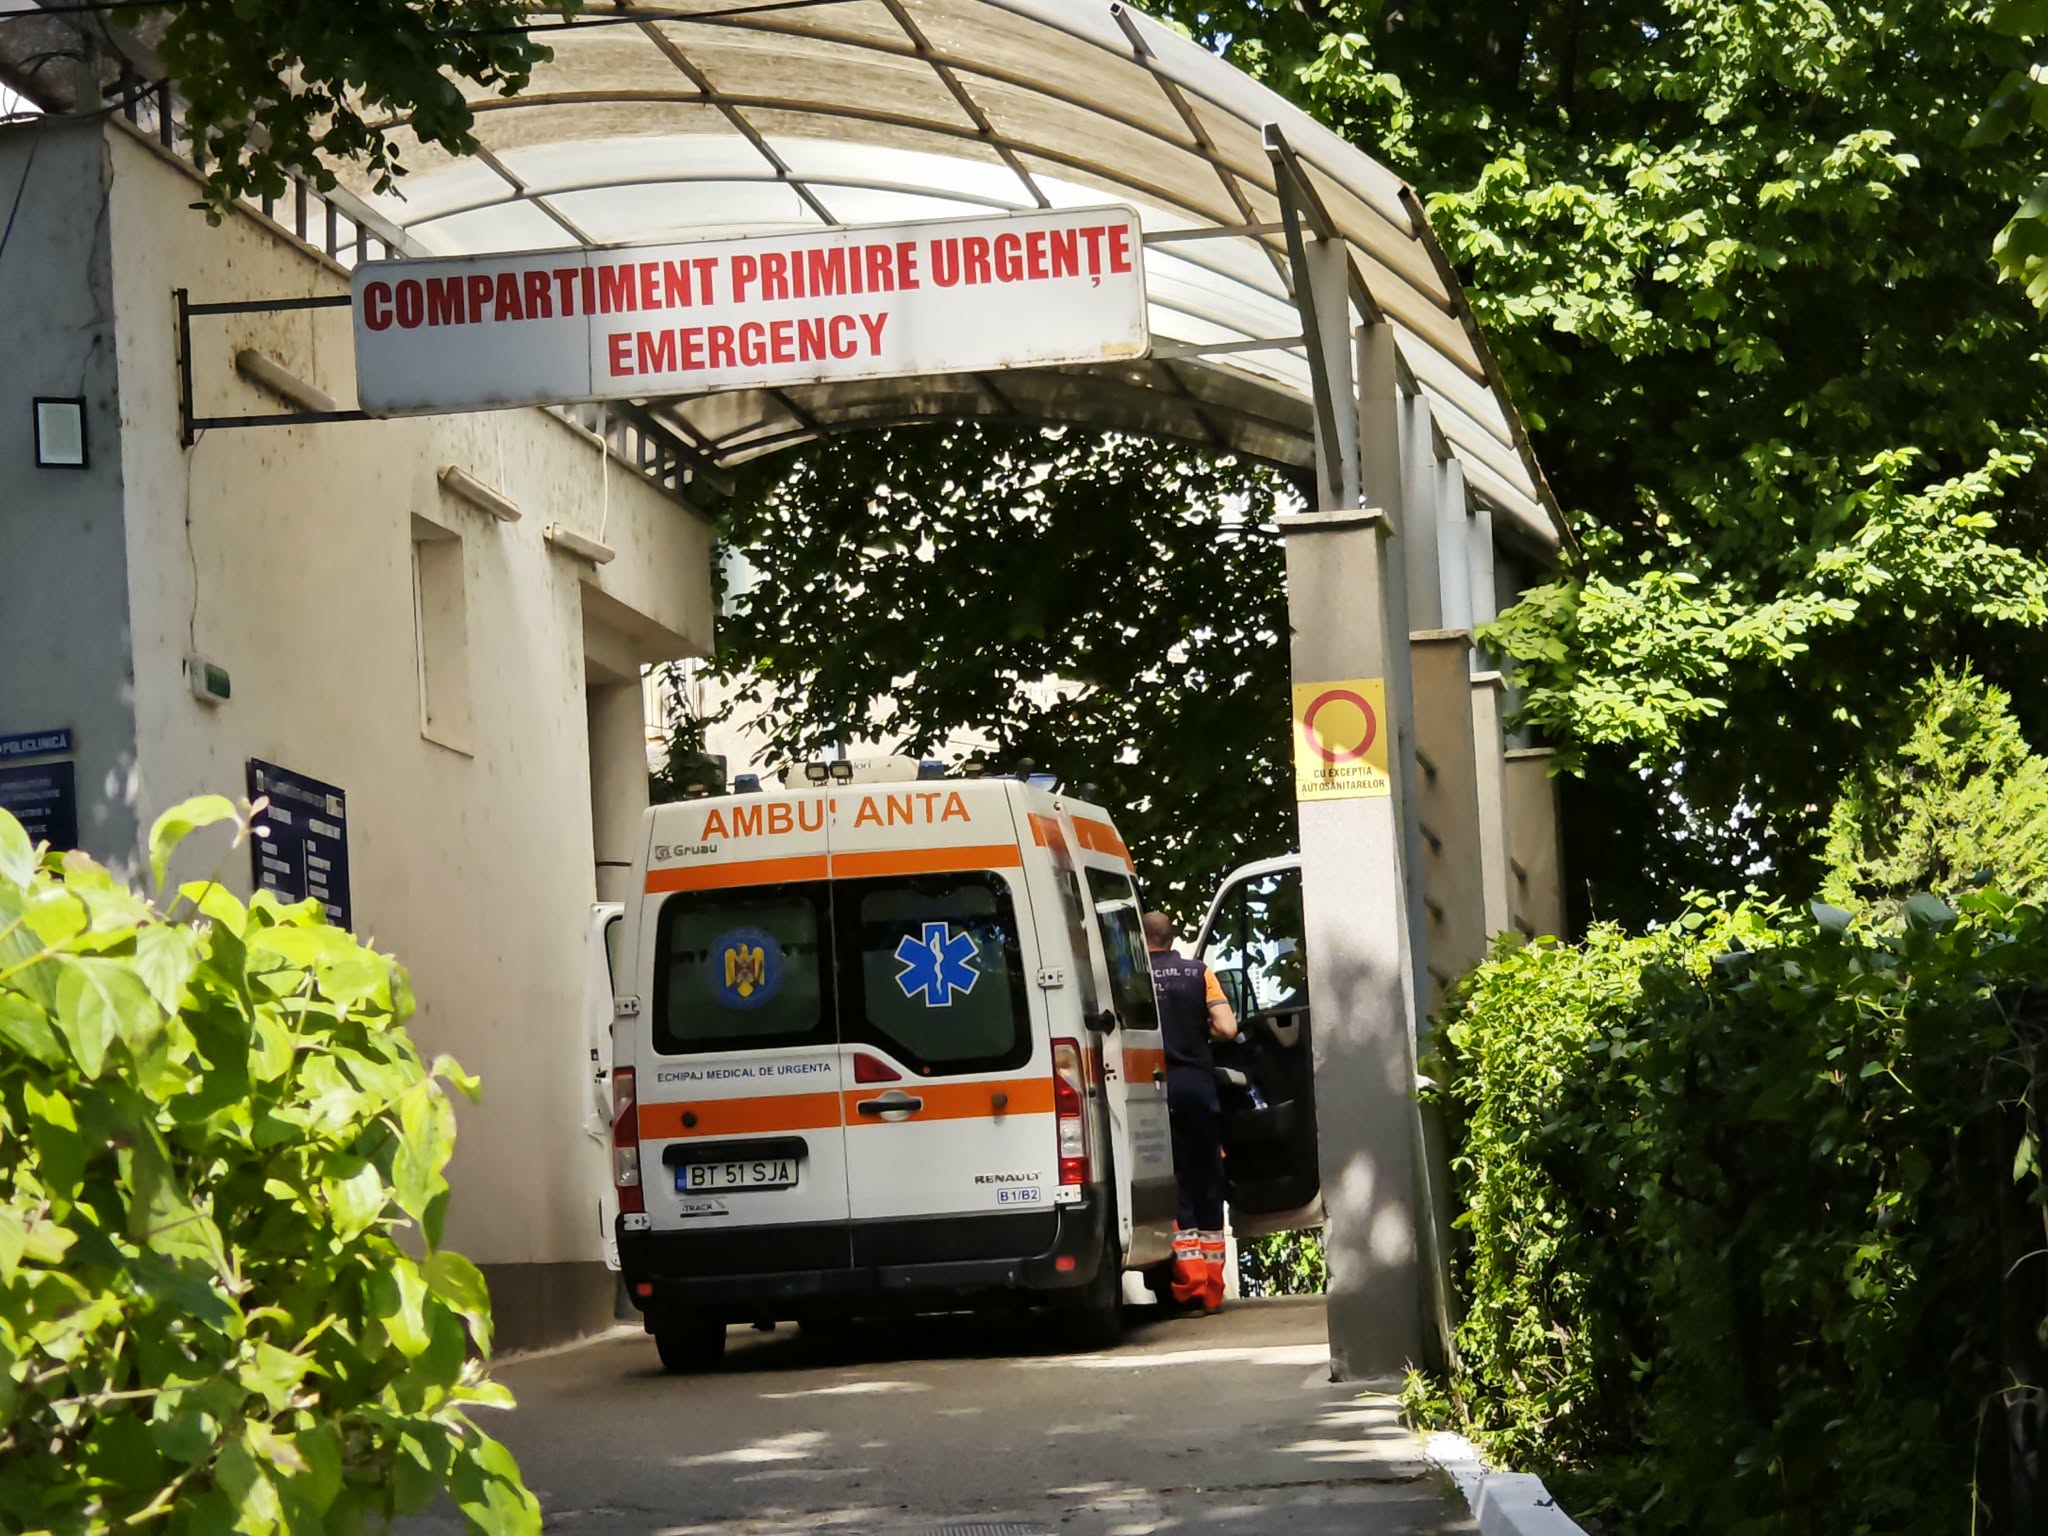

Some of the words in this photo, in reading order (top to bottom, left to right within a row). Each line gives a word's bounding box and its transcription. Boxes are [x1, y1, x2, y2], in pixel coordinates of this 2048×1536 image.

[363, 257, 719, 332] COMPARTIMENT
[731, 241, 920, 303] PRIMIRE
[930, 224, 1132, 288] URGENȚE
[608, 312, 888, 377] EMERGENCY
[1314, 768, 1326, 778] CU
[1301, 779, 1385, 792] AUTOSANITARELOR
[673, 844, 718, 857] Gruau
[657, 1070, 703, 1083] ECHIPAJ
[707, 1067, 755, 1080] MEDICAL
[759, 1066, 774, 1076] DE
[777, 1063, 831, 1076] URGENTA
[691, 1165, 718, 1185] BT
[726, 1163, 744, 1184] 51
[752, 1161, 789, 1182] SJA
[975, 1172, 1042, 1184] RENAULT
